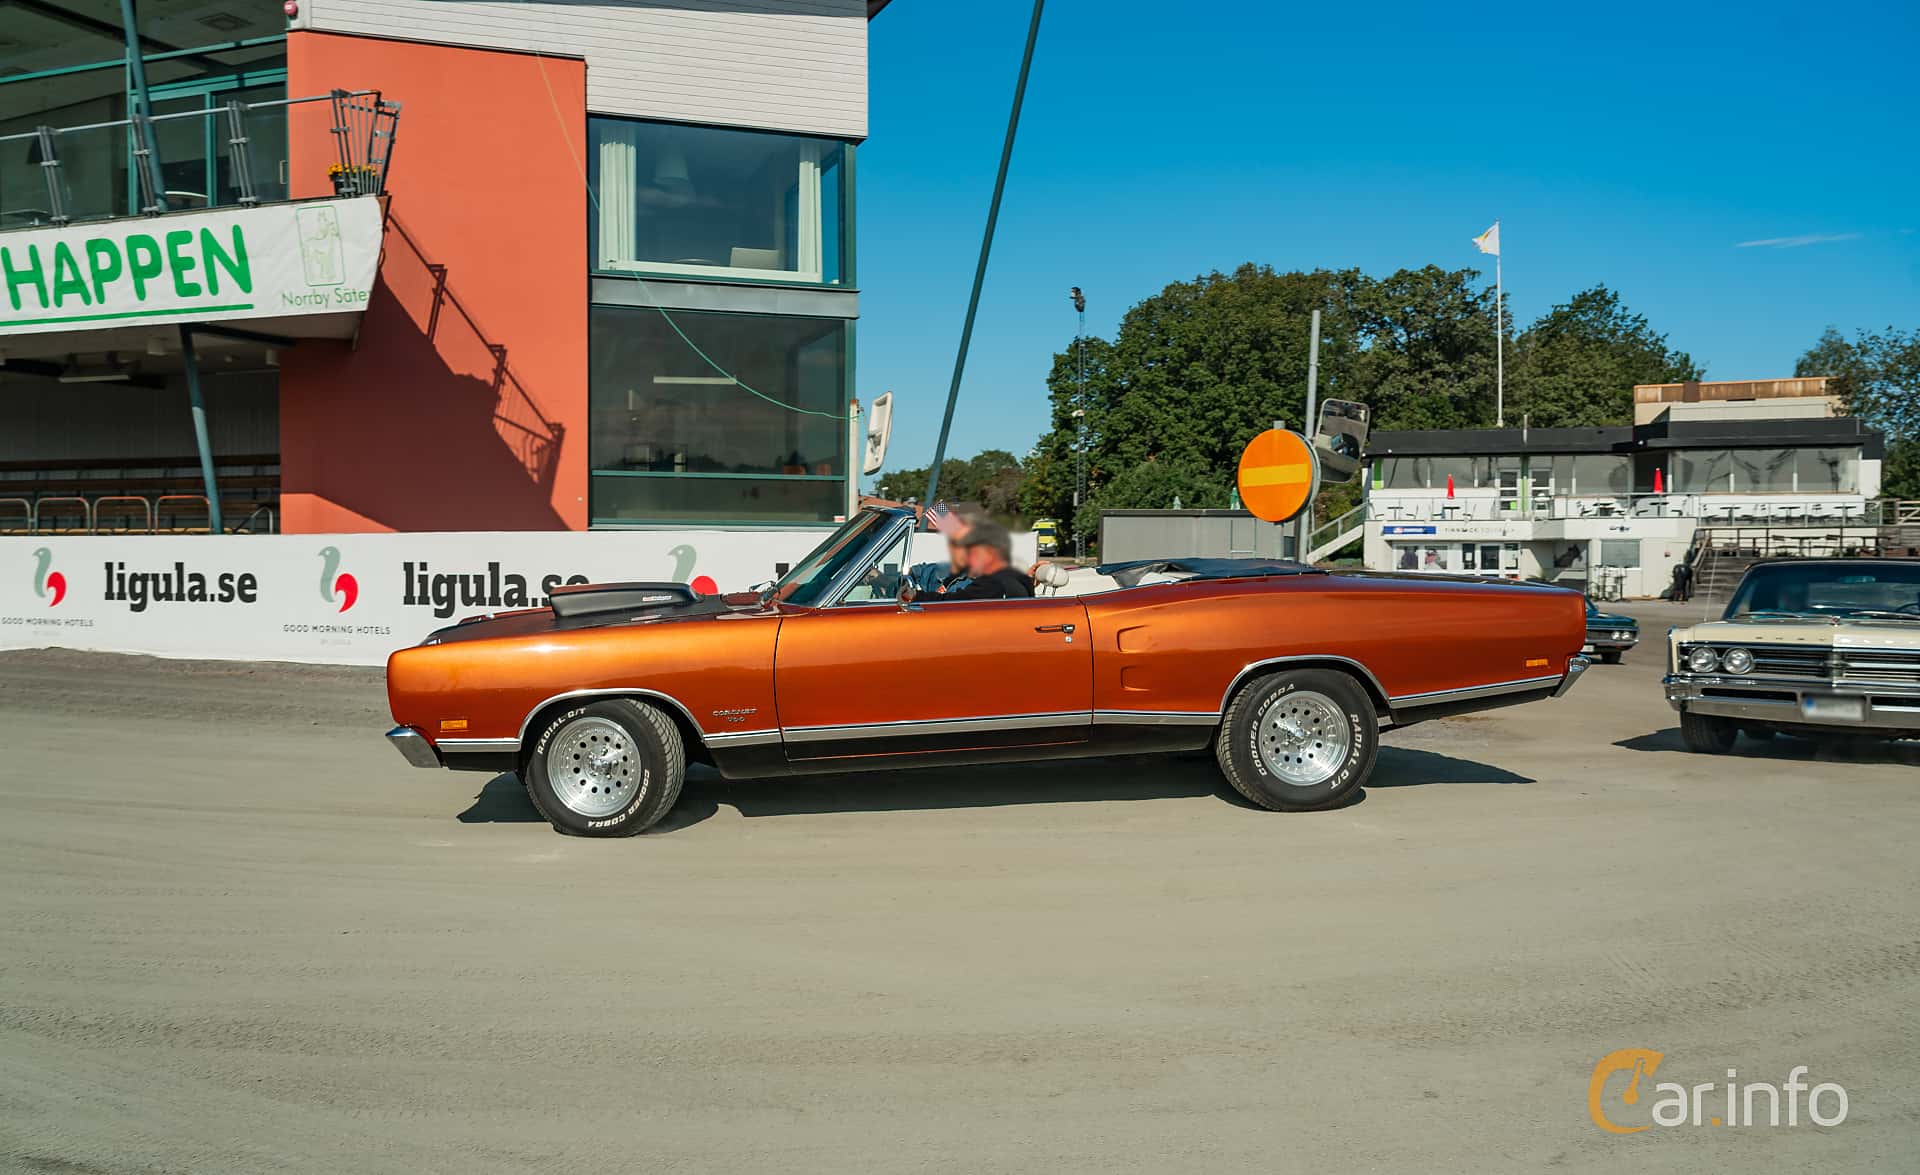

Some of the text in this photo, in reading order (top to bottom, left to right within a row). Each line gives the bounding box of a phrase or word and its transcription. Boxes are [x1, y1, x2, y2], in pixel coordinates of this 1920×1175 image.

[1, 224, 253, 310] HAPPEN
[281, 289, 329, 308] Norrby
[104, 561, 257, 613] ligula.se
[2, 616, 94, 627] GOOD MORNING HOTELS
[283, 624, 391, 635] GOOD MORNING HOTELS
[538, 717, 567, 754] RADIAL
[1250, 683, 1295, 776] COOPER COBRA
[1348, 713, 1363, 766] RADIAL
[588, 768, 650, 828] COOPER COBRA
